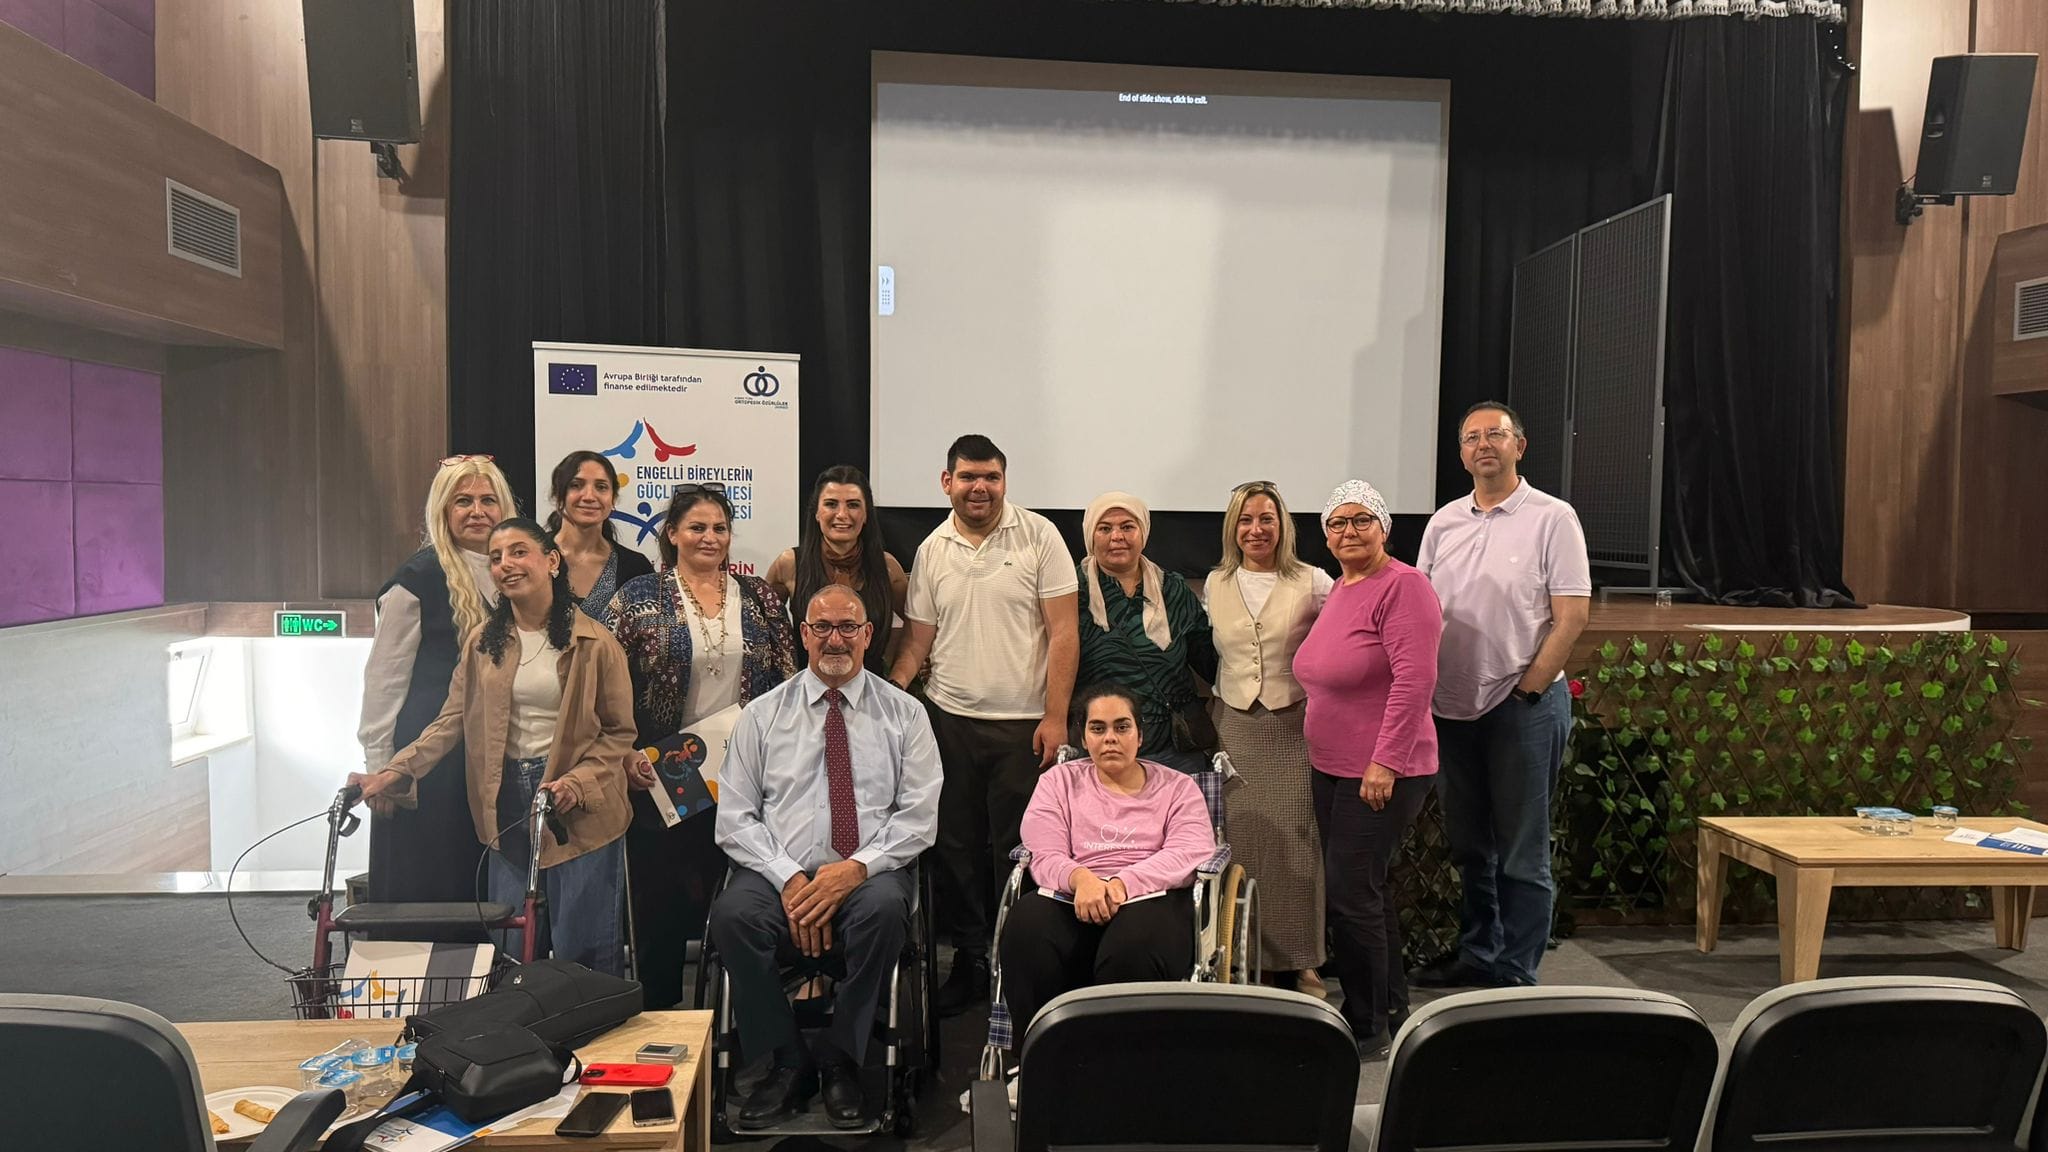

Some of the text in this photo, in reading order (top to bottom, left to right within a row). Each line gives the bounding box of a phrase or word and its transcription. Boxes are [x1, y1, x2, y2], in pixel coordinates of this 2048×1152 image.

[1119, 93, 1208, 104] End of slide show, click to exit.
[603, 372, 702, 383] Avrupa Birliği tarafından
[604, 382, 688, 392] finanse edilmektedir
[637, 464, 753, 481] ENGELLİ BİREYLERİN
[302, 618, 323, 632] WC
